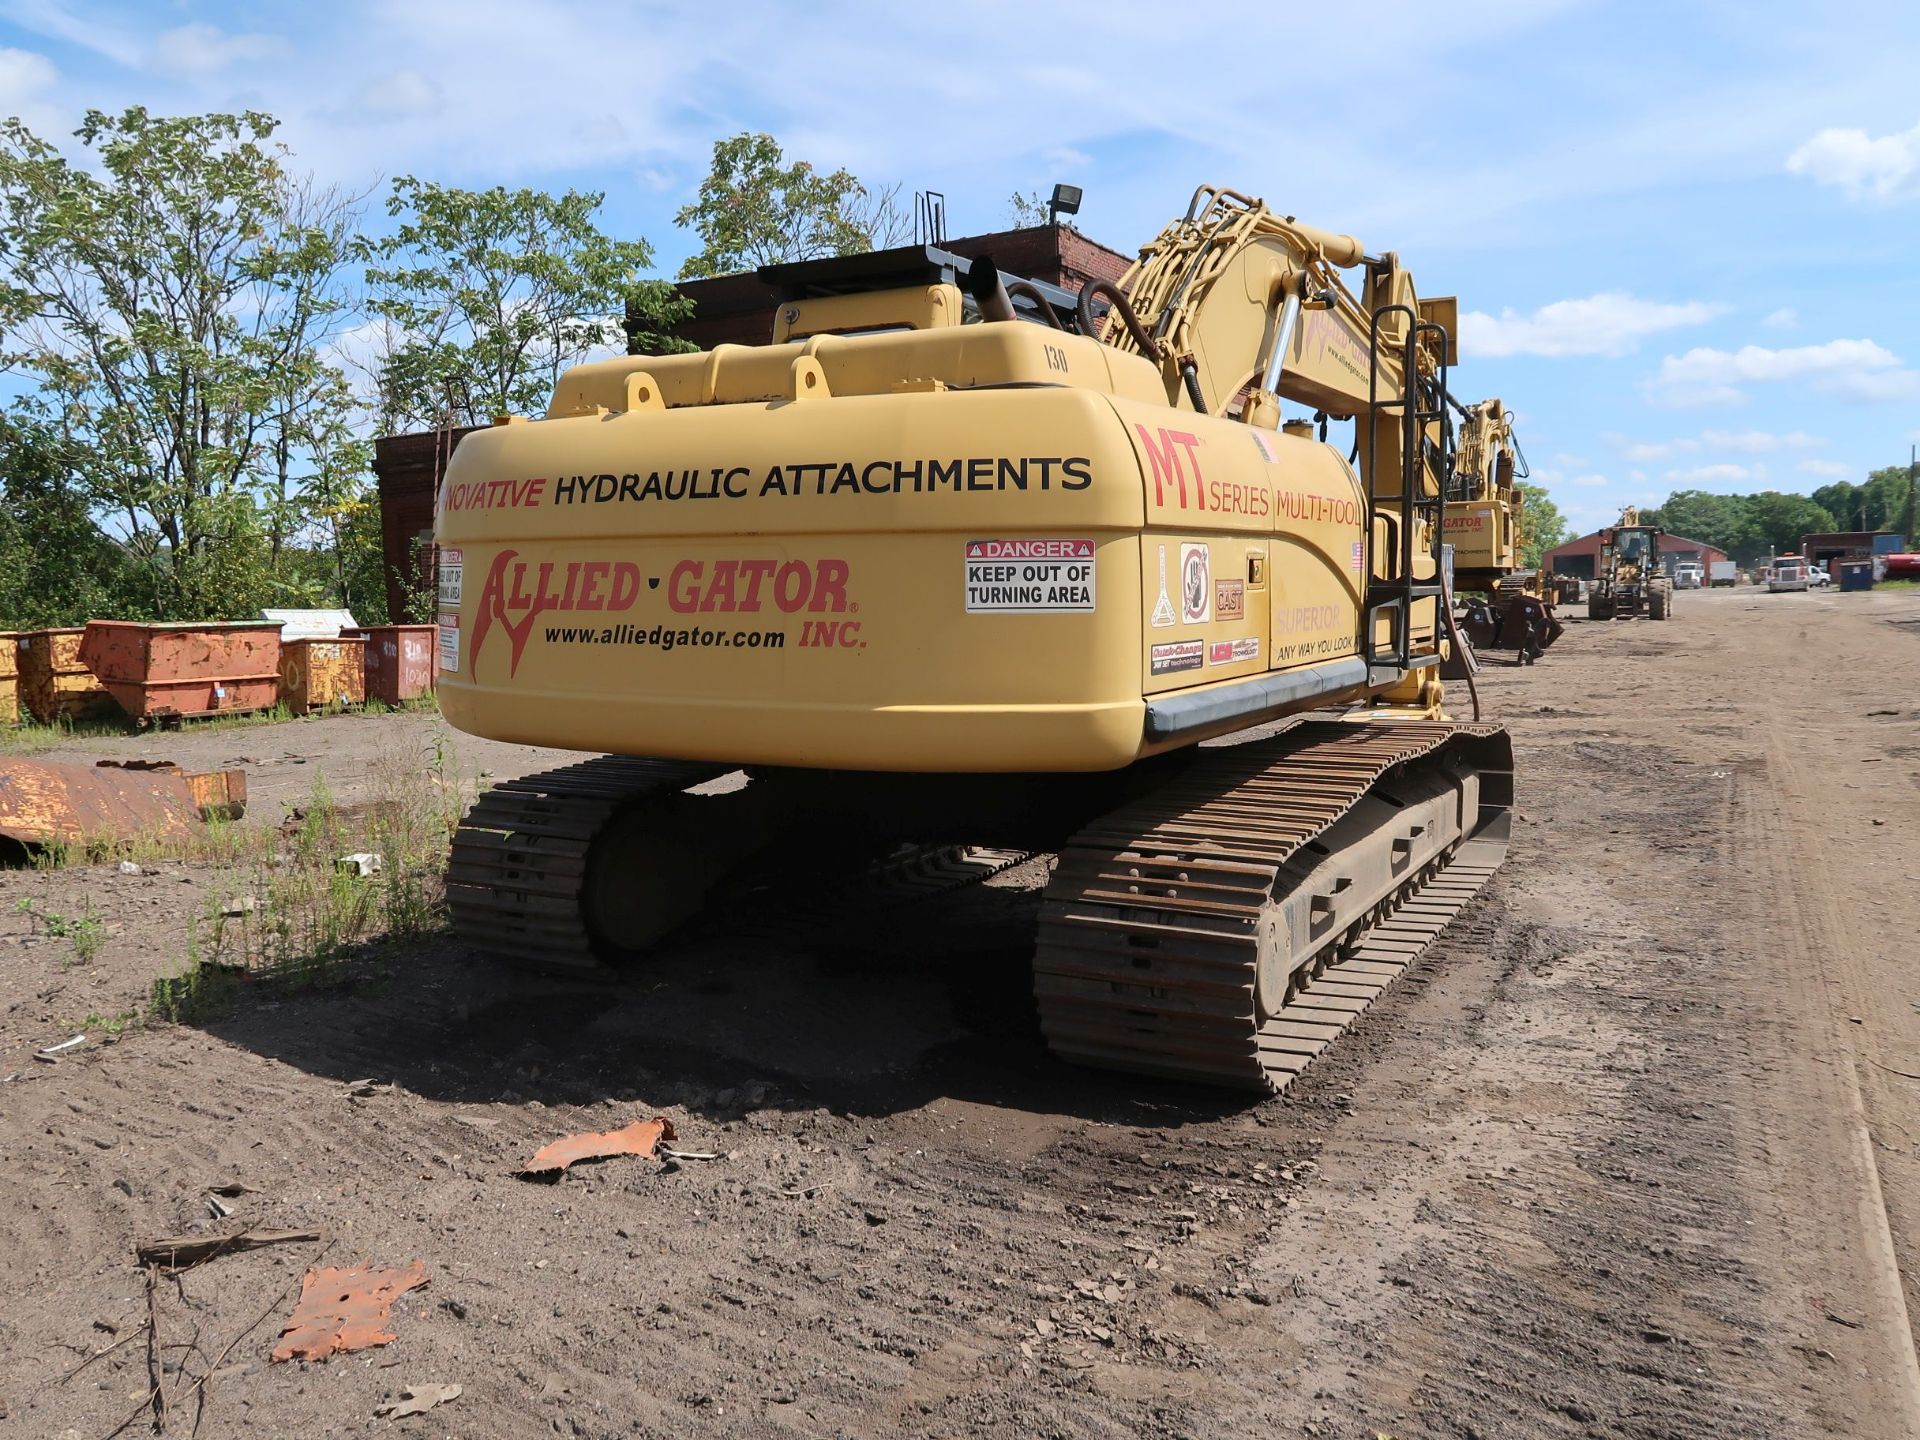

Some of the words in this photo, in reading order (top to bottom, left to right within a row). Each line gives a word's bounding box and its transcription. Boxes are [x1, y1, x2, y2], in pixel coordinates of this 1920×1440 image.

[1044, 344, 1068, 373] 130
[445, 478, 547, 511] NOVATIVE
[555, 467, 750, 505] HYDRAULIC
[759, 457, 1093, 496] ATTACHMENTS
[1134, 423, 1205, 510] MT
[1210, 481, 1269, 516] SERIES
[1276, 489, 1361, 526] MULTI-TOOL
[1443, 517, 1482, 528] GATOR
[986, 541, 1075, 557] DANGER
[668, 559, 850, 614] GATOR
[968, 566, 1017, 582] KEEP
[1022, 566, 1062, 582] OUT
[1067, 566, 1091, 582] OF
[968, 587, 1042, 604] TURNING
[1047, 587, 1091, 603] AREA
[1217, 591, 1243, 611] CAST
[1276, 604, 1341, 636] SUPERIOR
[545, 625, 785, 651] www.alliedgator.com
[798, 621, 867, 648] INC.
[1277, 645, 1297, 661] ANY
[1298, 641, 1316, 657] WAY
[1317, 639, 1333, 654] YOU
[1333, 636, 1353, 651] LOOK
[1170, 657, 1202, 667] technology
